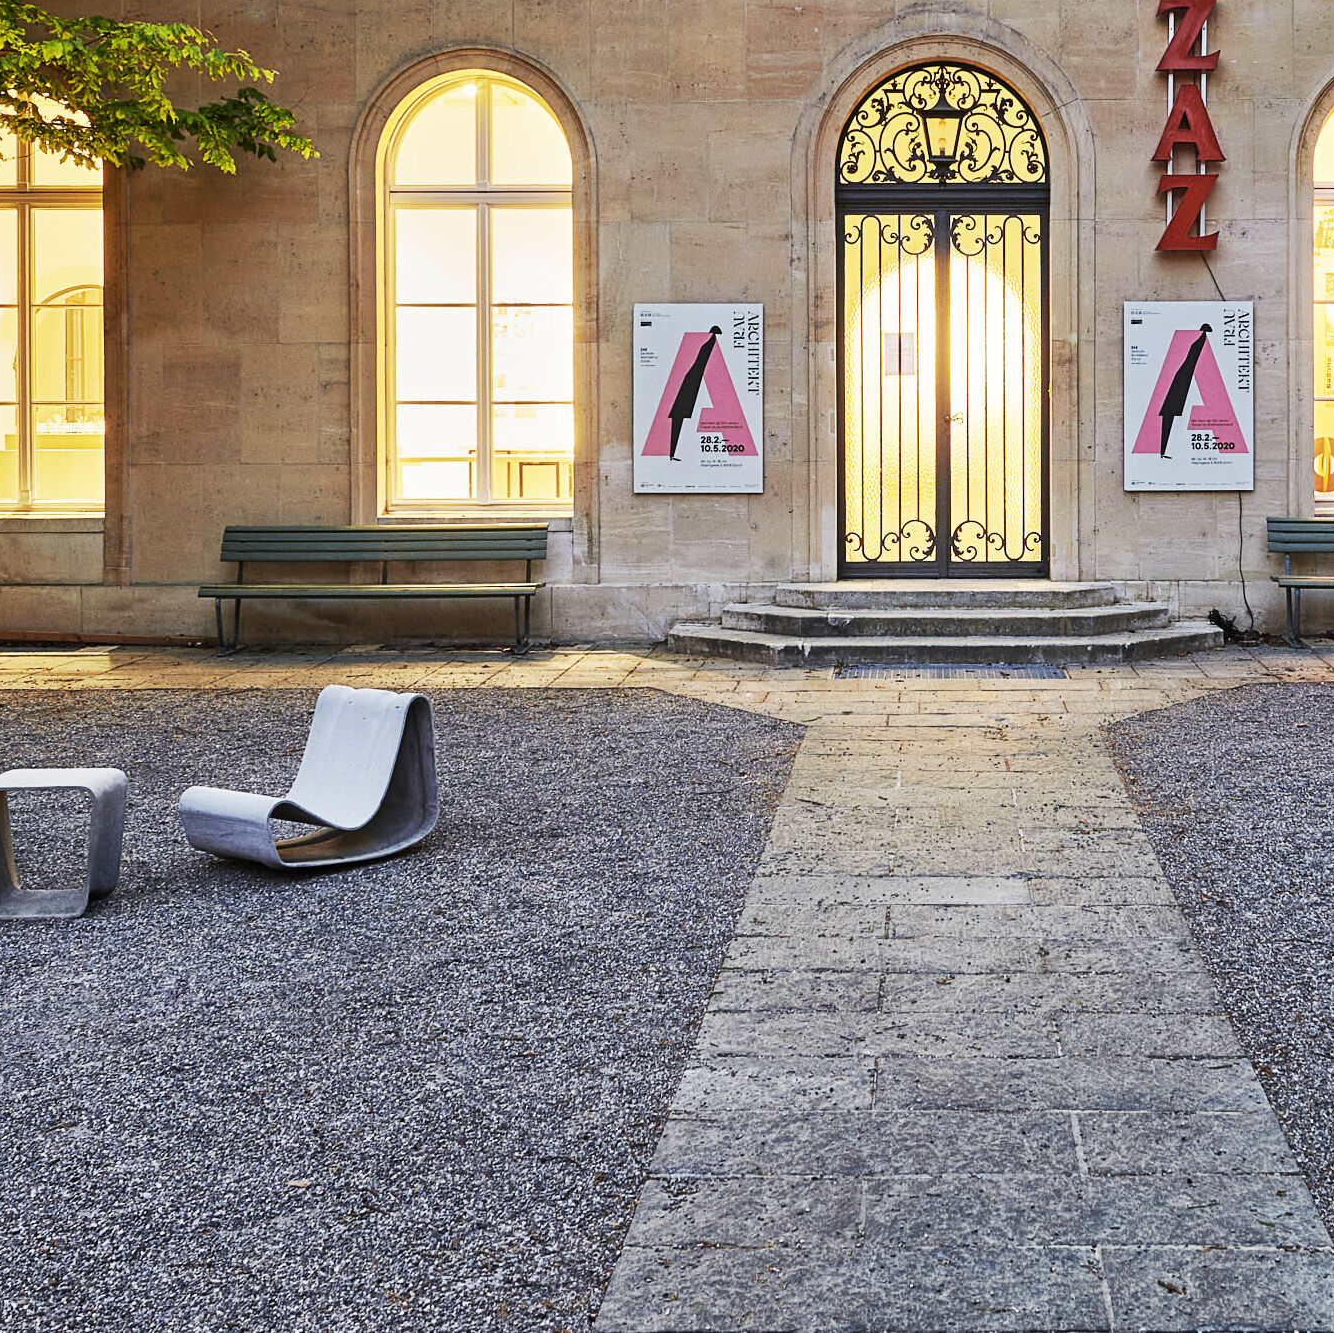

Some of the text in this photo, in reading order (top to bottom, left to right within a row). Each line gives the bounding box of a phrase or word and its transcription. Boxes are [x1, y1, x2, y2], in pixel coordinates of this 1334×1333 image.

[733, 311, 745, 349] FRAU
[1223, 309, 1235, 346] FRAU
[1191, 442, 1235, 450] 10.5.2020
